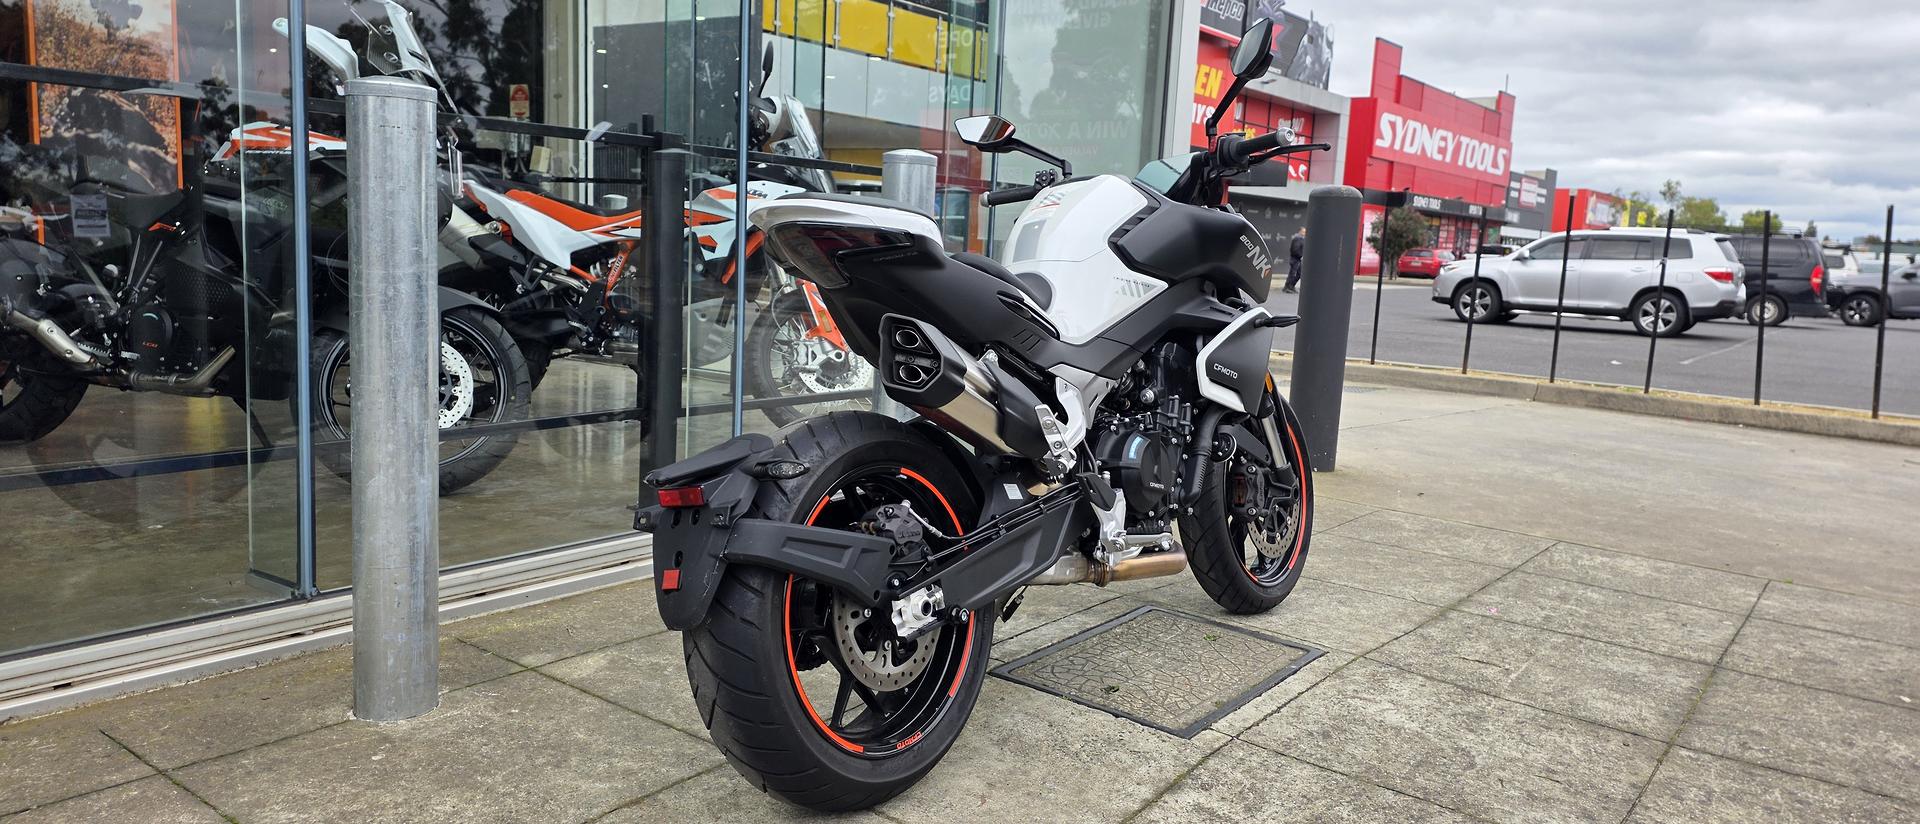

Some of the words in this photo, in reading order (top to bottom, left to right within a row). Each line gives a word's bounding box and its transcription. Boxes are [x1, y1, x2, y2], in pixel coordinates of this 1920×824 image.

[1195, 64, 1223, 99] EN
[1376, 112, 1459, 163] SYDNEY
[1457, 135, 1508, 176] TOOLS
[1214, 363, 1238, 379] CFMOTO
[896, 731, 923, 749] CFMOTO
